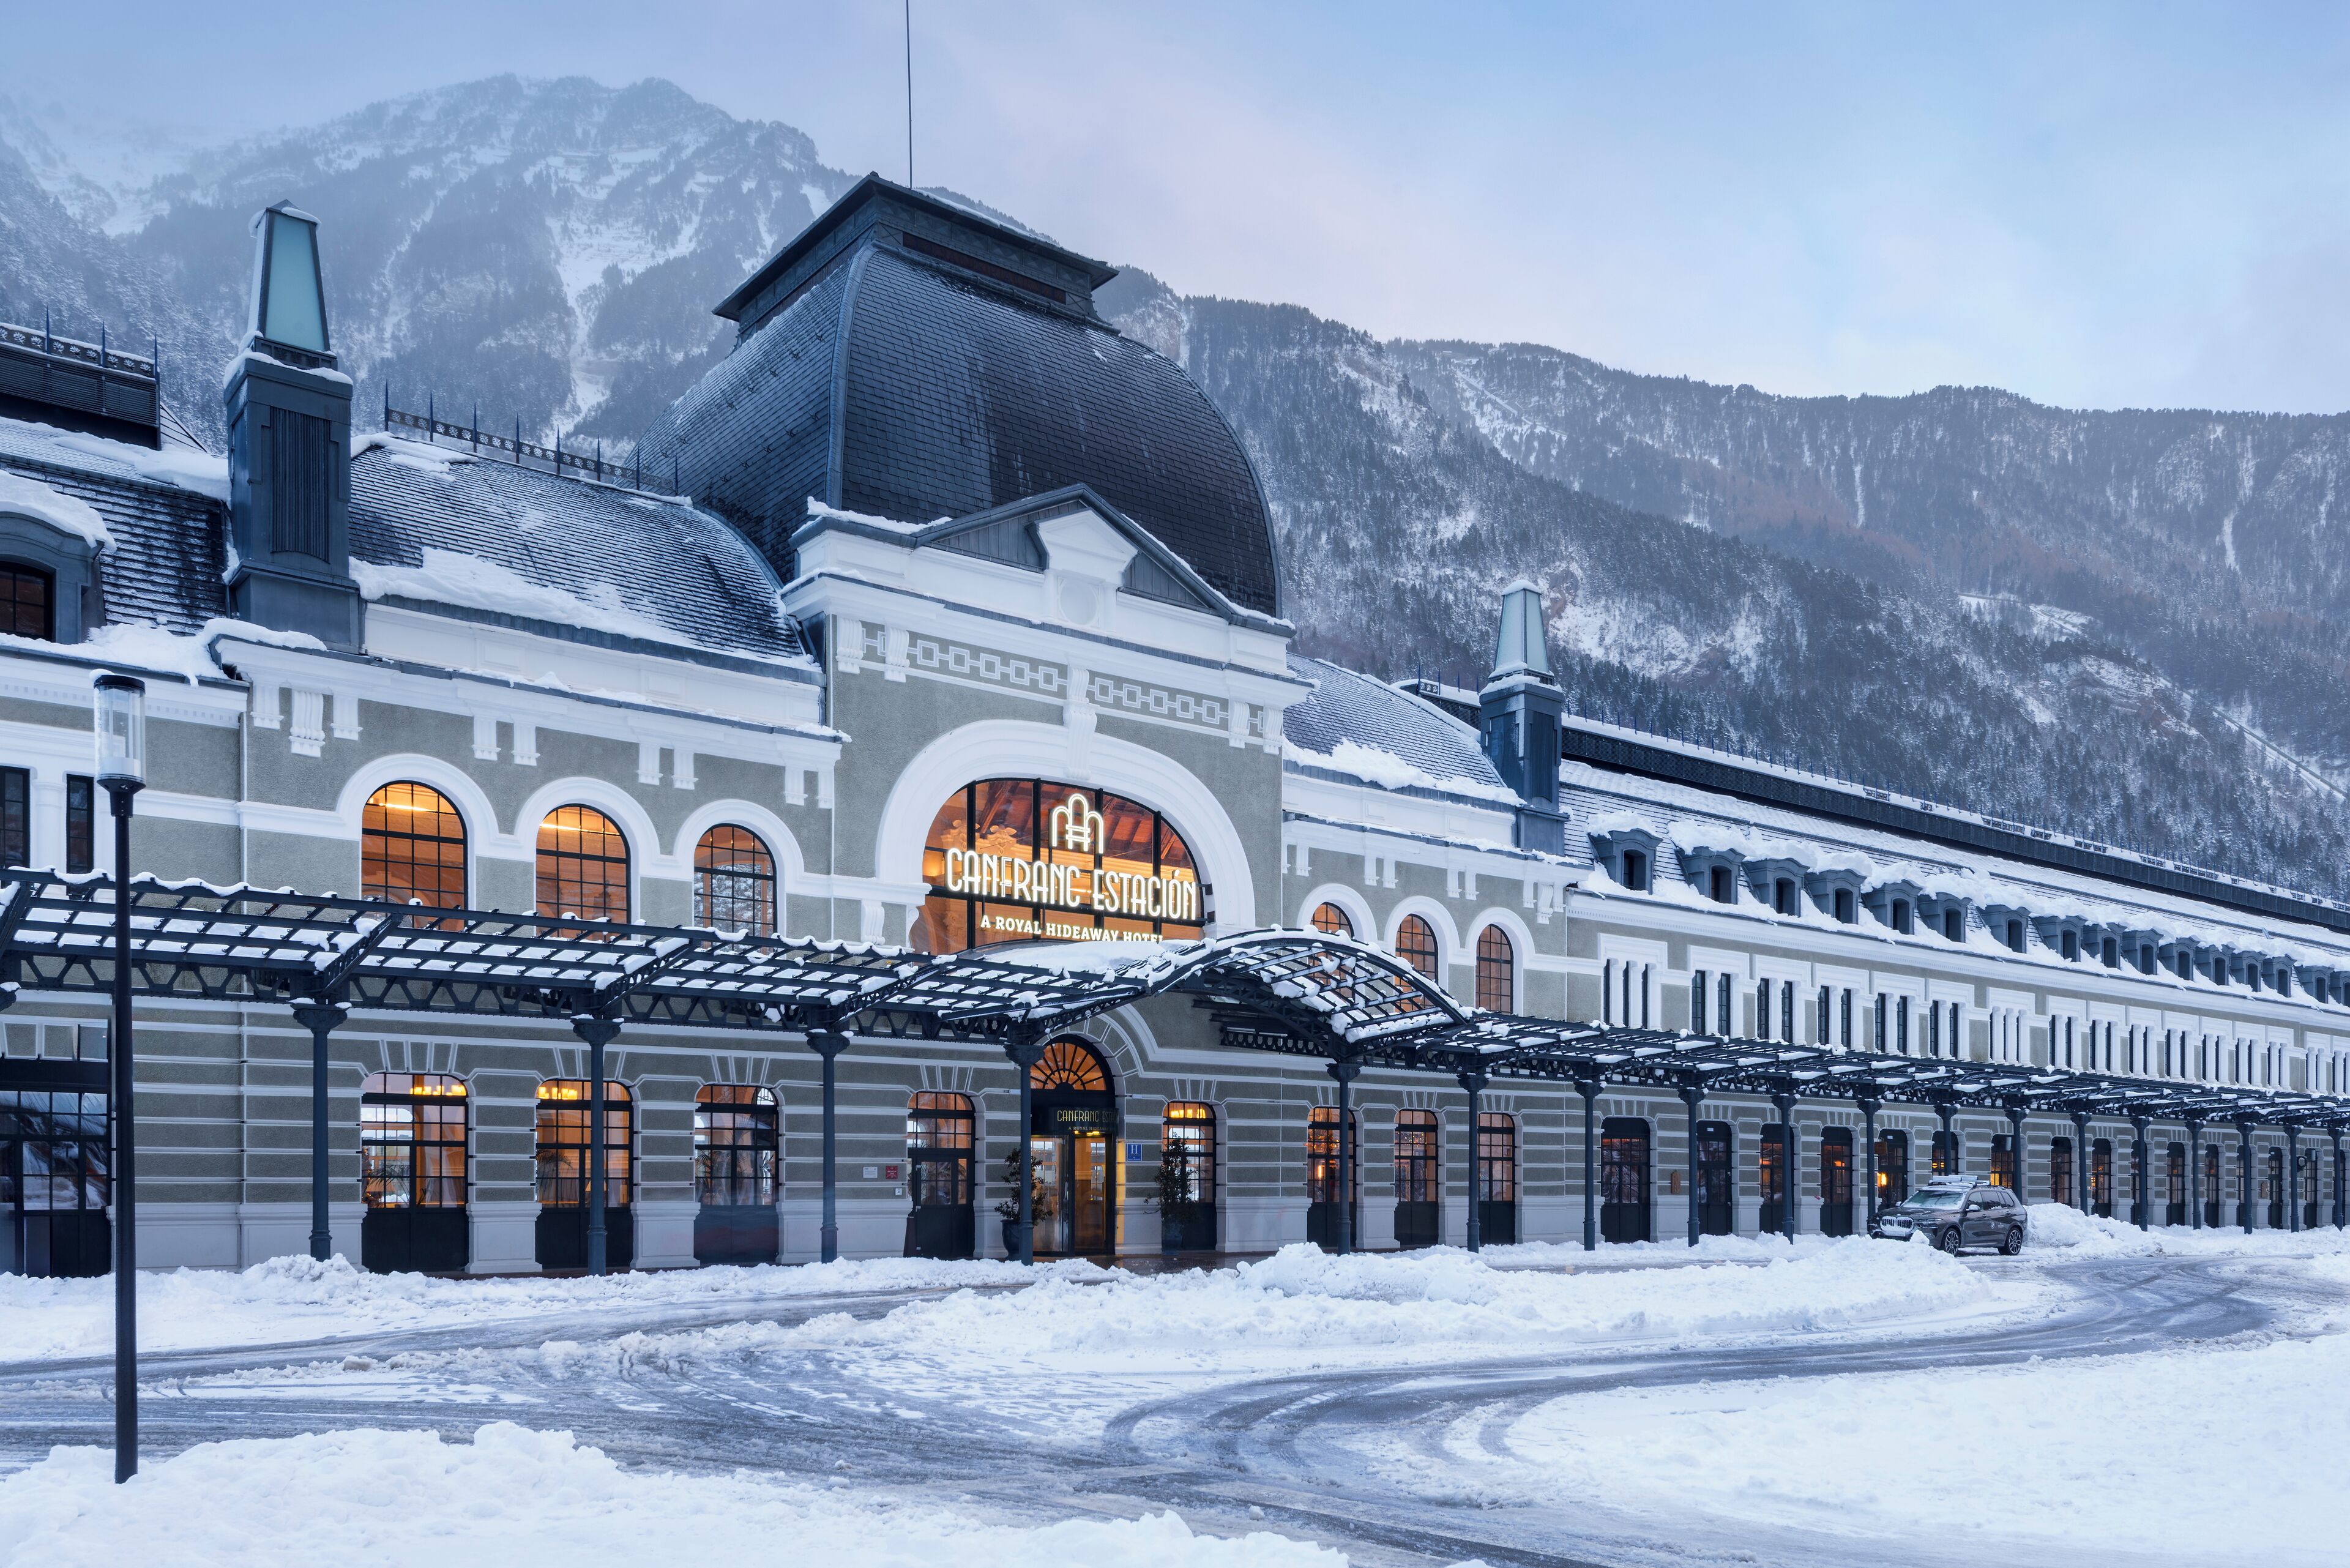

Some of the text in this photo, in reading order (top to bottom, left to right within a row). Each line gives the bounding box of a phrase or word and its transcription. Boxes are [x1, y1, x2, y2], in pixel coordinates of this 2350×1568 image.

[947, 847, 1196, 920] CANFRANC ESTACIÓN
[980, 914, 991, 928] A
[995, 916, 1042, 935] ROYAL
[1046, 923, 1119, 942] HIDEAWAY
[1057, 1110, 1099, 1122] CANFRANC
[1131, 1144, 1138, 1154] H
